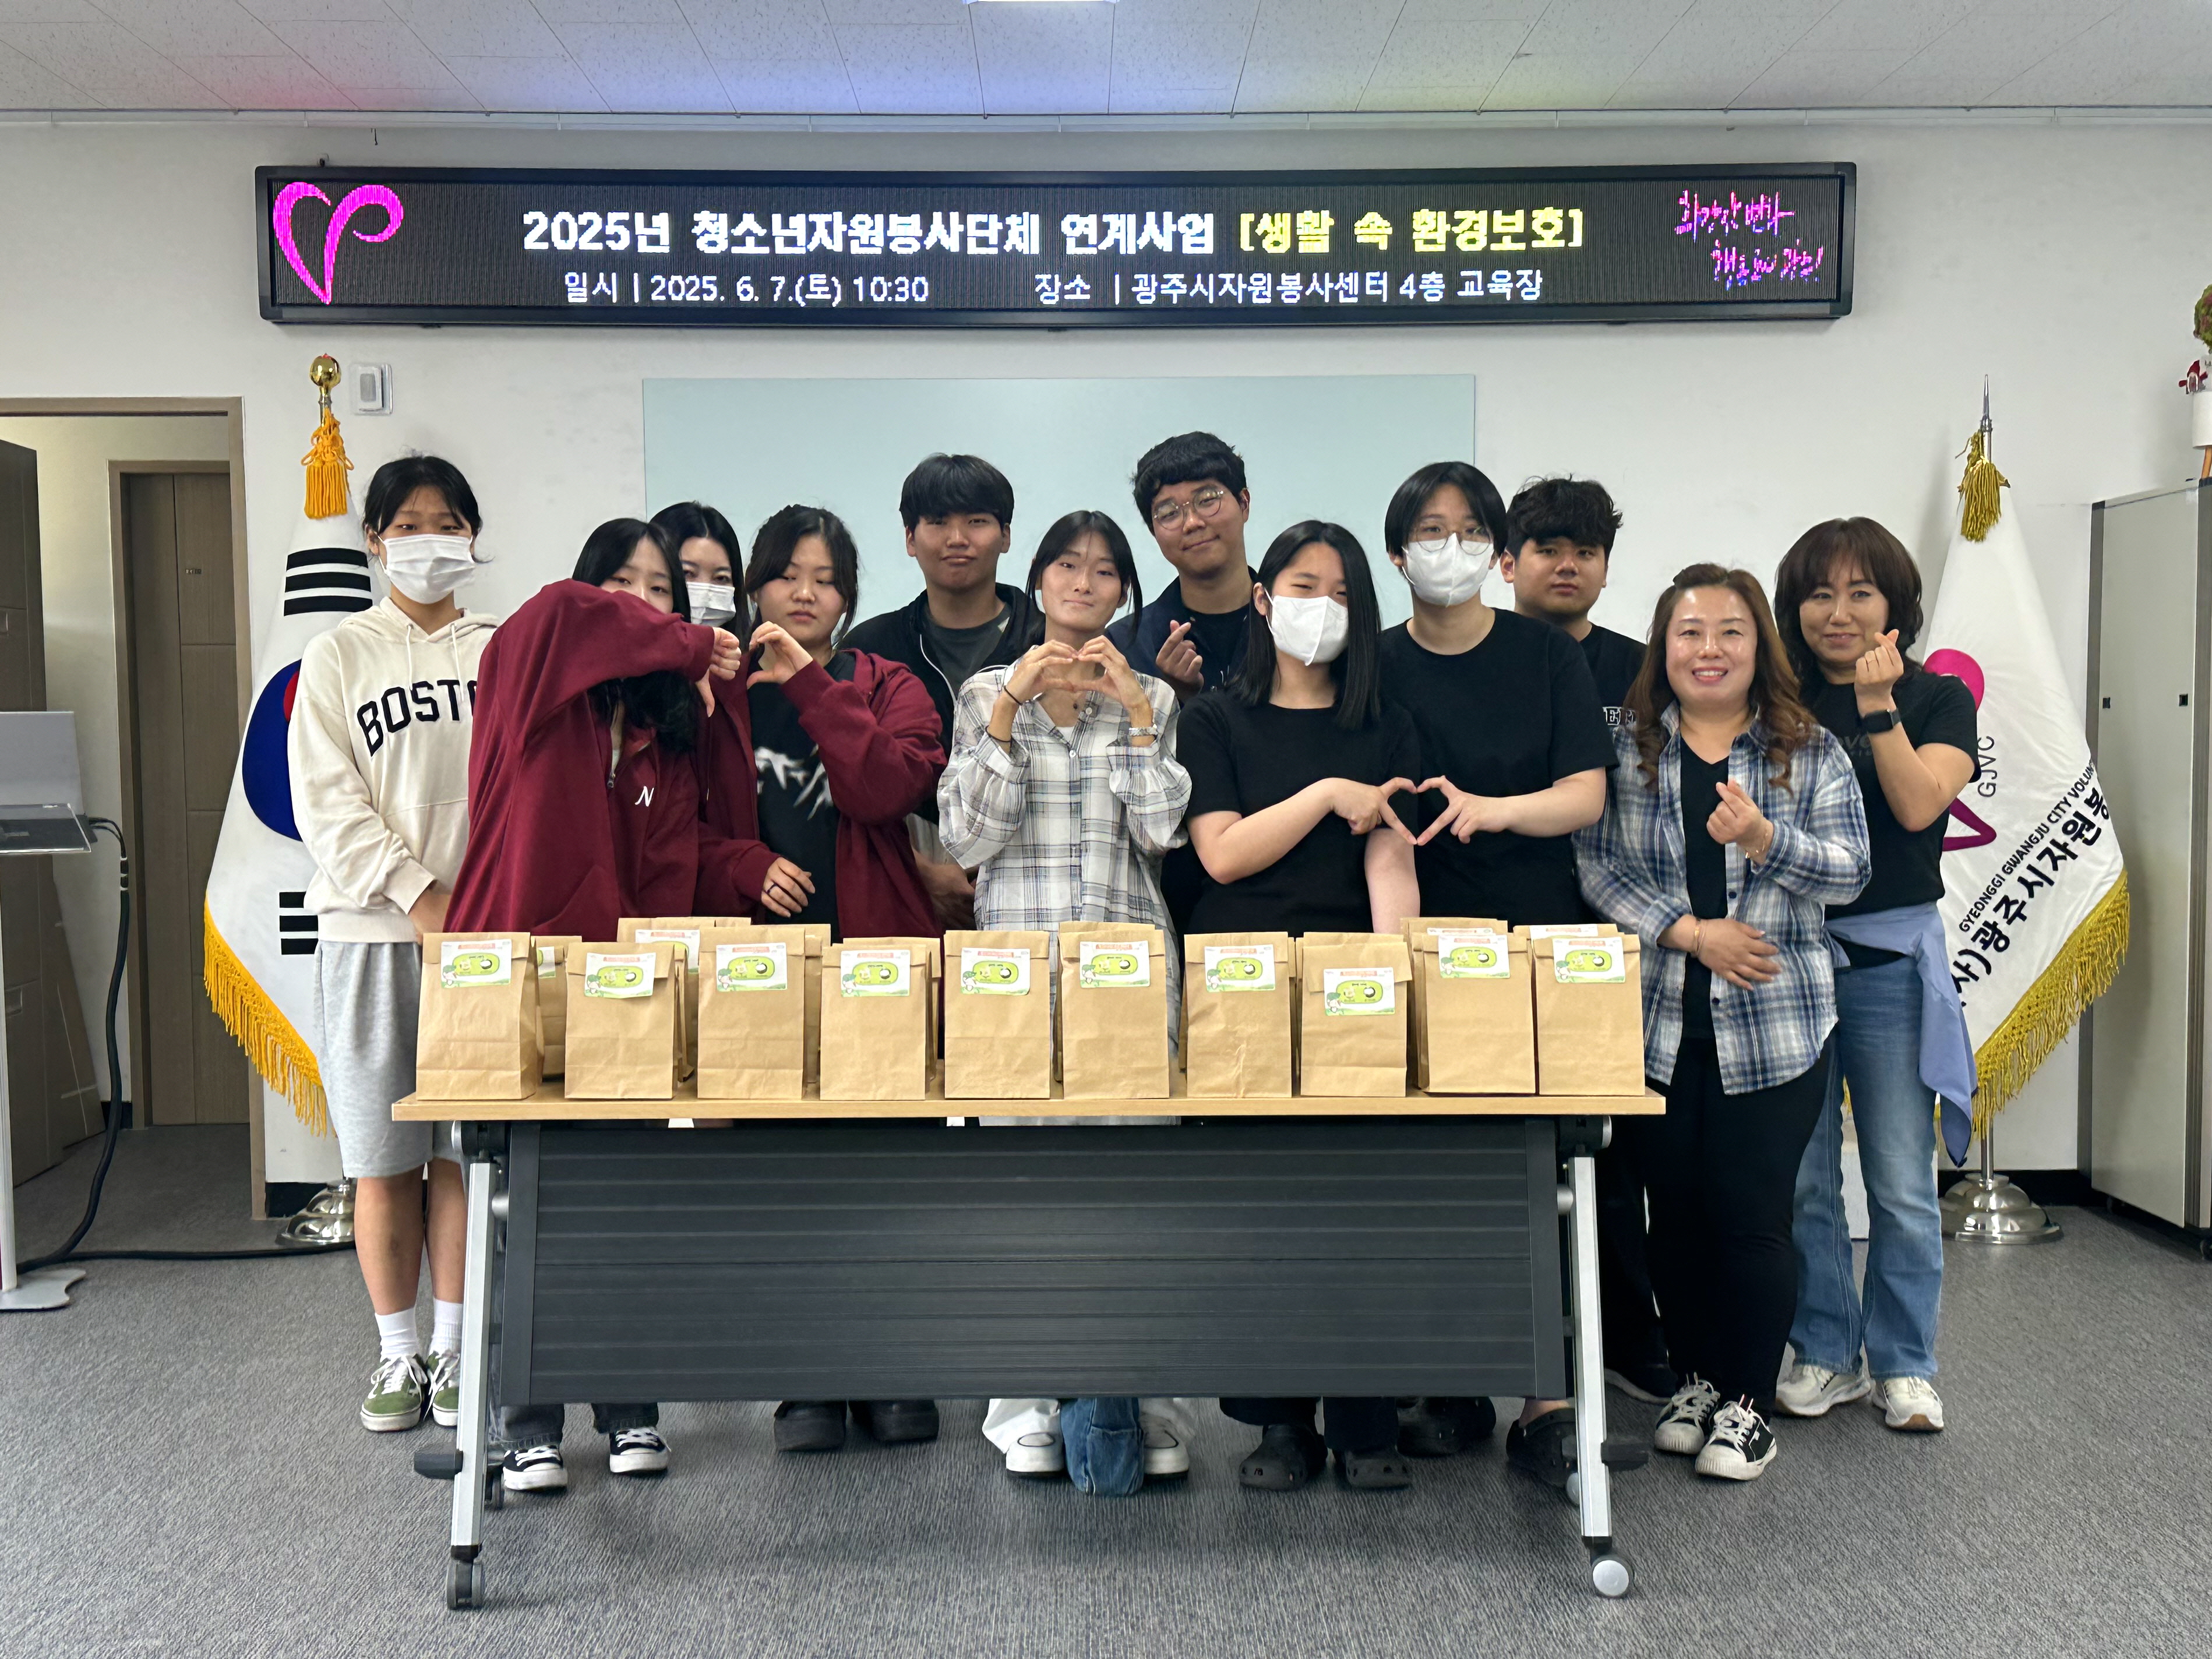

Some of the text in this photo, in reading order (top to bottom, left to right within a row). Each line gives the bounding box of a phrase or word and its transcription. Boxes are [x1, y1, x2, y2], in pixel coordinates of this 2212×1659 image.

[523, 207, 1583, 256] 2025년 청소년자원봉사단체 연계사업 [생활 속 환경보호]
[565, 271, 618, 303] 일시
[650, 274, 725, 302] 2025.
[736, 276, 760, 302] 6.
[853, 276, 929, 302] 10:30
[1035, 273, 1091, 305] 장소
[1131, 270, 1388, 305] 광주시자원봉사센터
[1399, 271, 1445, 302] 4층
[1456, 269, 1543, 301] 교육장
[1977, 736, 1998, 797] GJVC
[1959, 873, 2006, 933] GYEONGGI
[2001, 822, 2050, 875] GWANGJU
[2047, 796, 2072, 824] CITY
